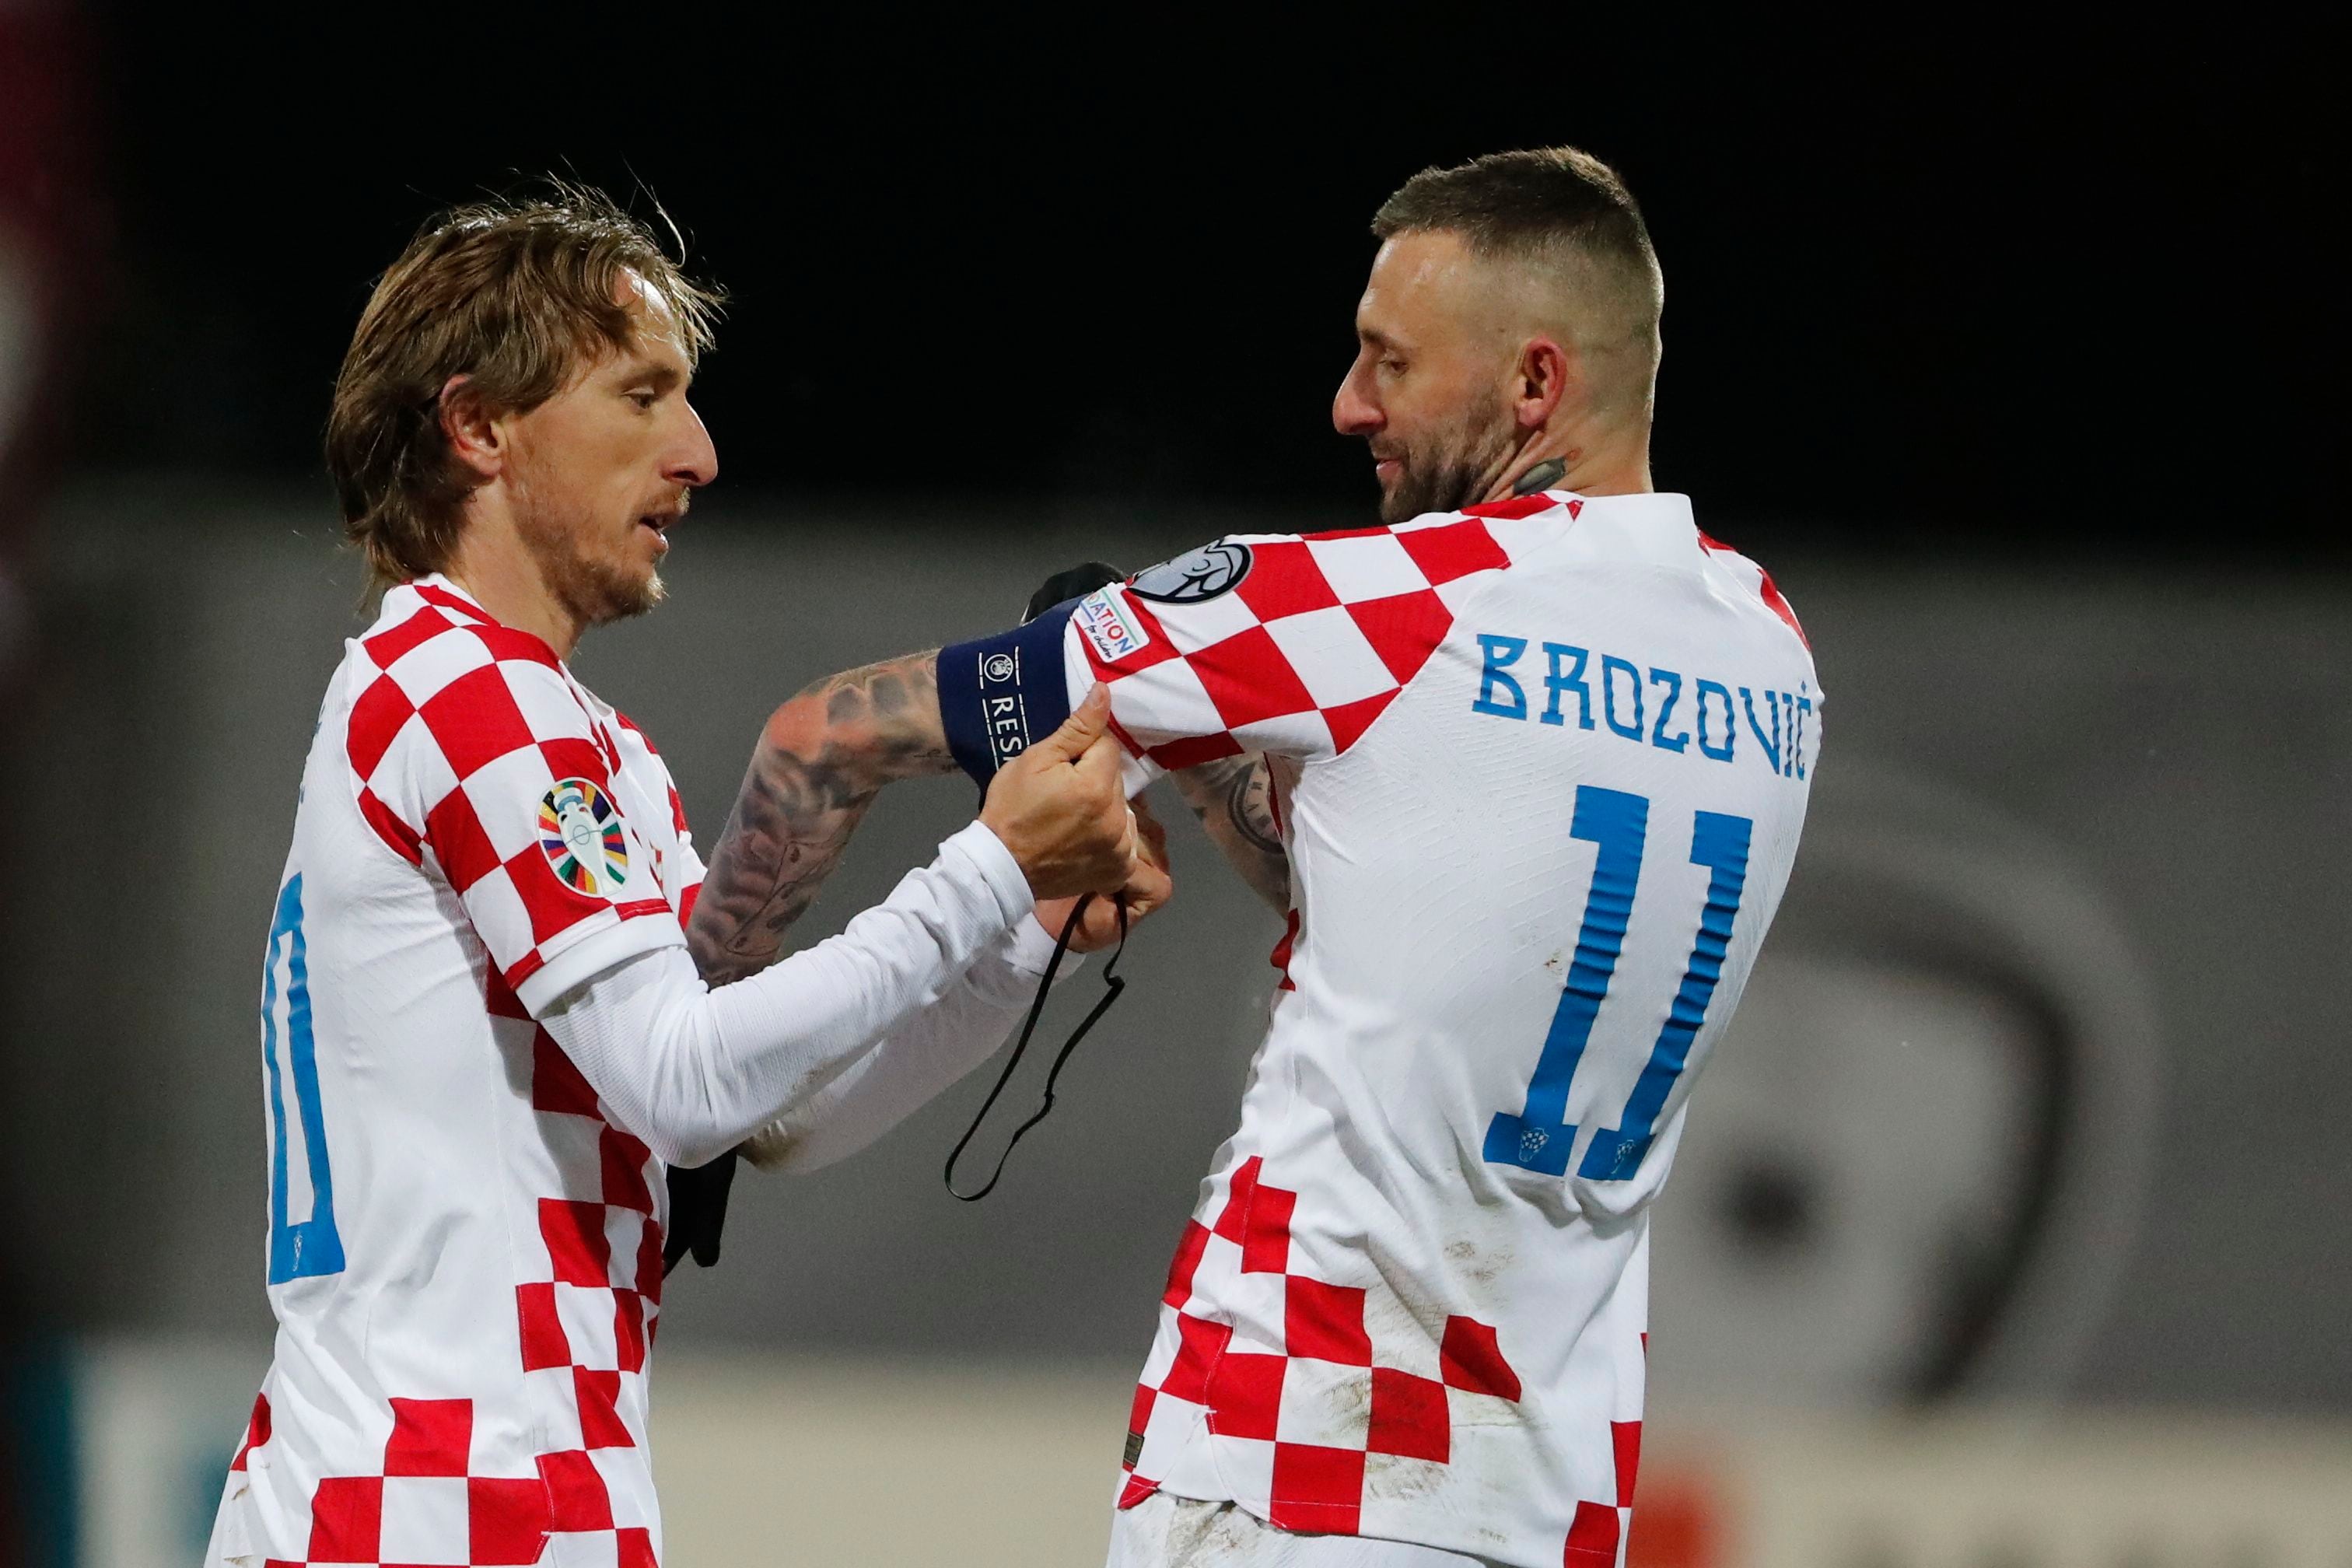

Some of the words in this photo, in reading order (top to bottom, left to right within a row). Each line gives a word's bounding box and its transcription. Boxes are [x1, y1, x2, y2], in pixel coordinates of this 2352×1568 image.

[991, 697, 1022, 761] RES
[1472, 633, 1811, 780] BROZOVIĆ
[1482, 785, 1753, 1181] 11
